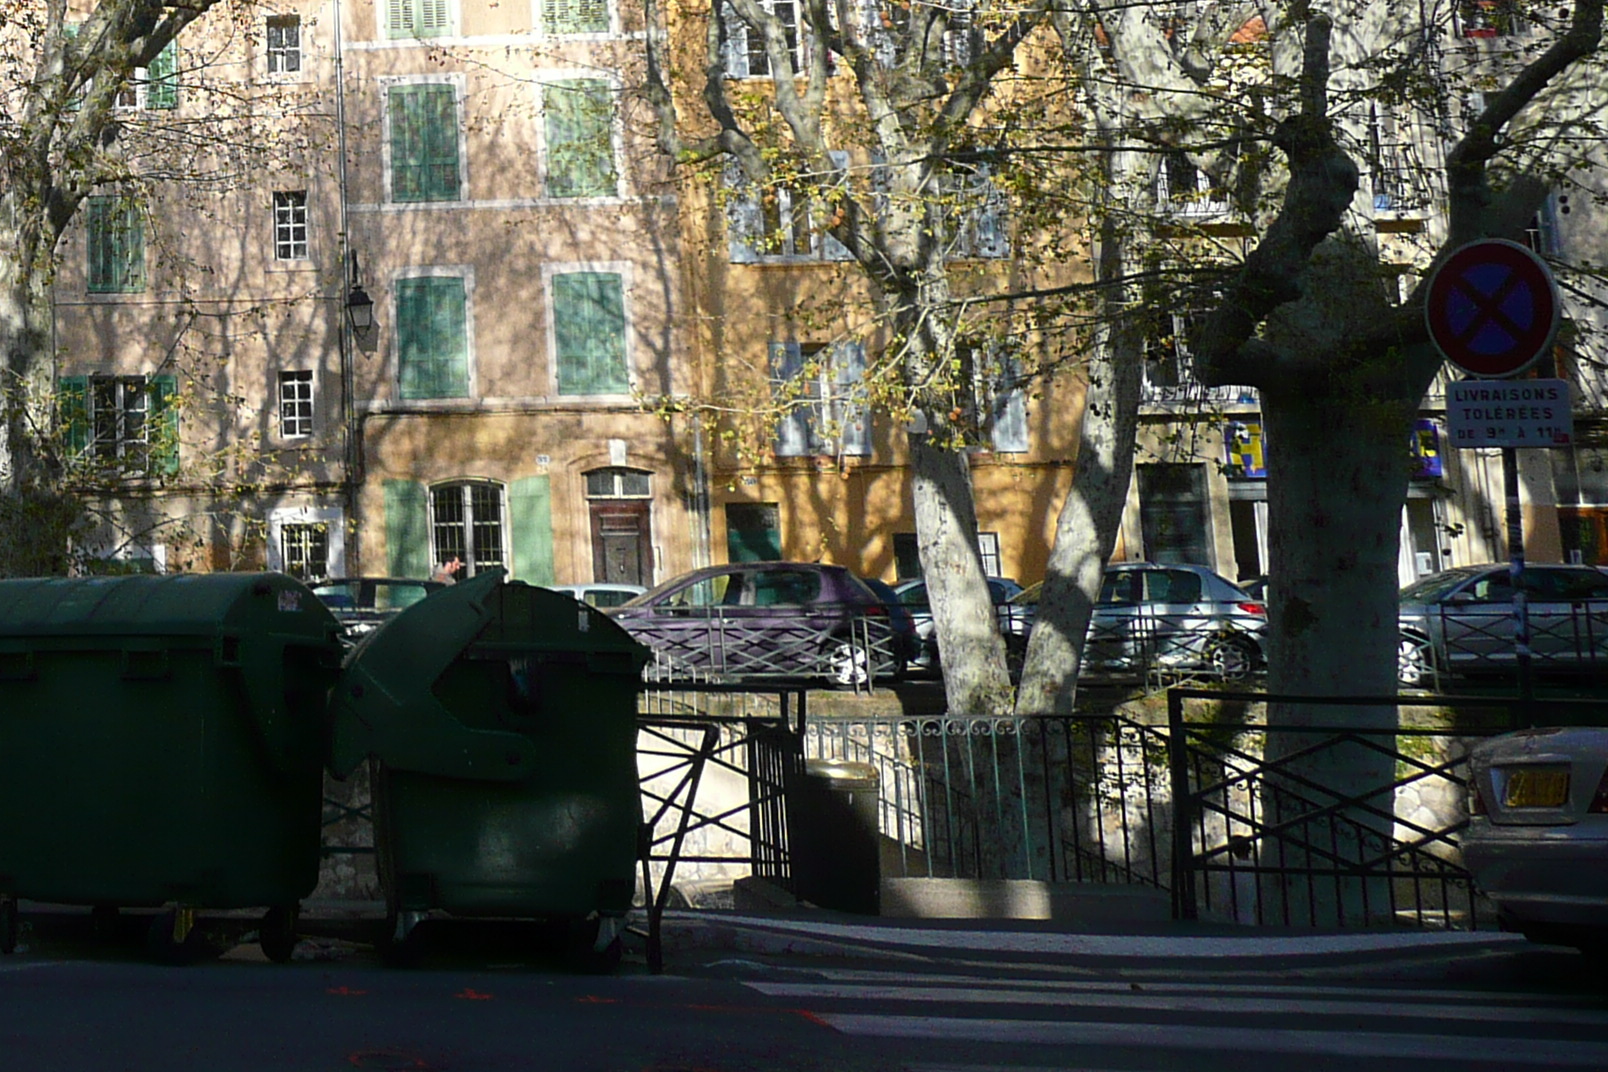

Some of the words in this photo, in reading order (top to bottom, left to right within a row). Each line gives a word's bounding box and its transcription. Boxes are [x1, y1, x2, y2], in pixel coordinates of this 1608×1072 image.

[1454, 388, 1558, 402] LIVRAISONS
[1462, 405, 1554, 420] TOLÉRÉES
[1457, 429, 1475, 439] DE
